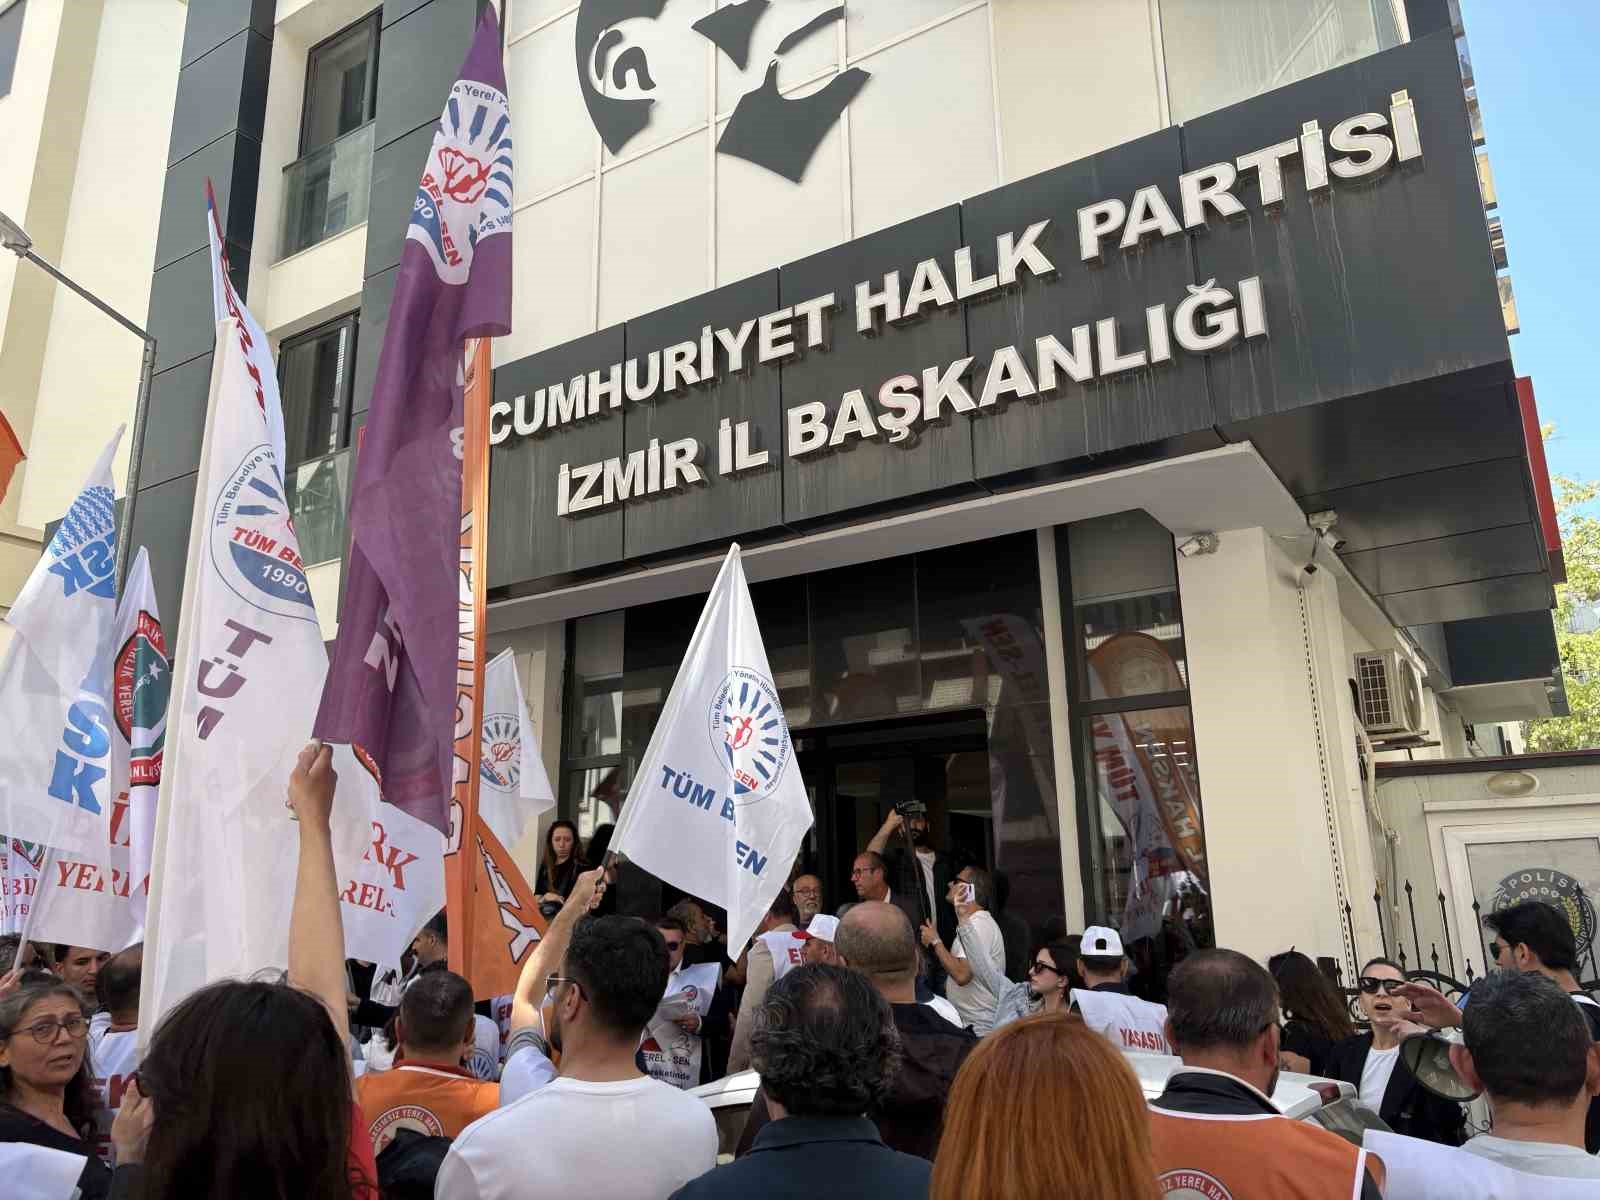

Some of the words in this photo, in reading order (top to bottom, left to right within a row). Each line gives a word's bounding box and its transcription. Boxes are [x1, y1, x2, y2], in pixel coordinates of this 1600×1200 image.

[490, 291, 835, 445] CUMHURİYET
[855, 219, 1056, 333] HALK
[1076, 88, 1423, 262] PARTİSİ
[556, 438, 702, 517] İZMİR
[717, 417, 770, 476] İL
[786, 275, 1267, 458] BAŞKANLIĞI
[215, 503, 230, 527] Tüm
[229, 455, 263, 501] Belediye
[231, 525, 278, 554] TÜM
[261, 564, 307, 594] 1990
[661, 764, 716, 811] TÜM
[734, 769, 759, 791] SEN
[1508, 871, 1569, 889] POLİS
[1175, 1175, 1206, 1192] YEREL
